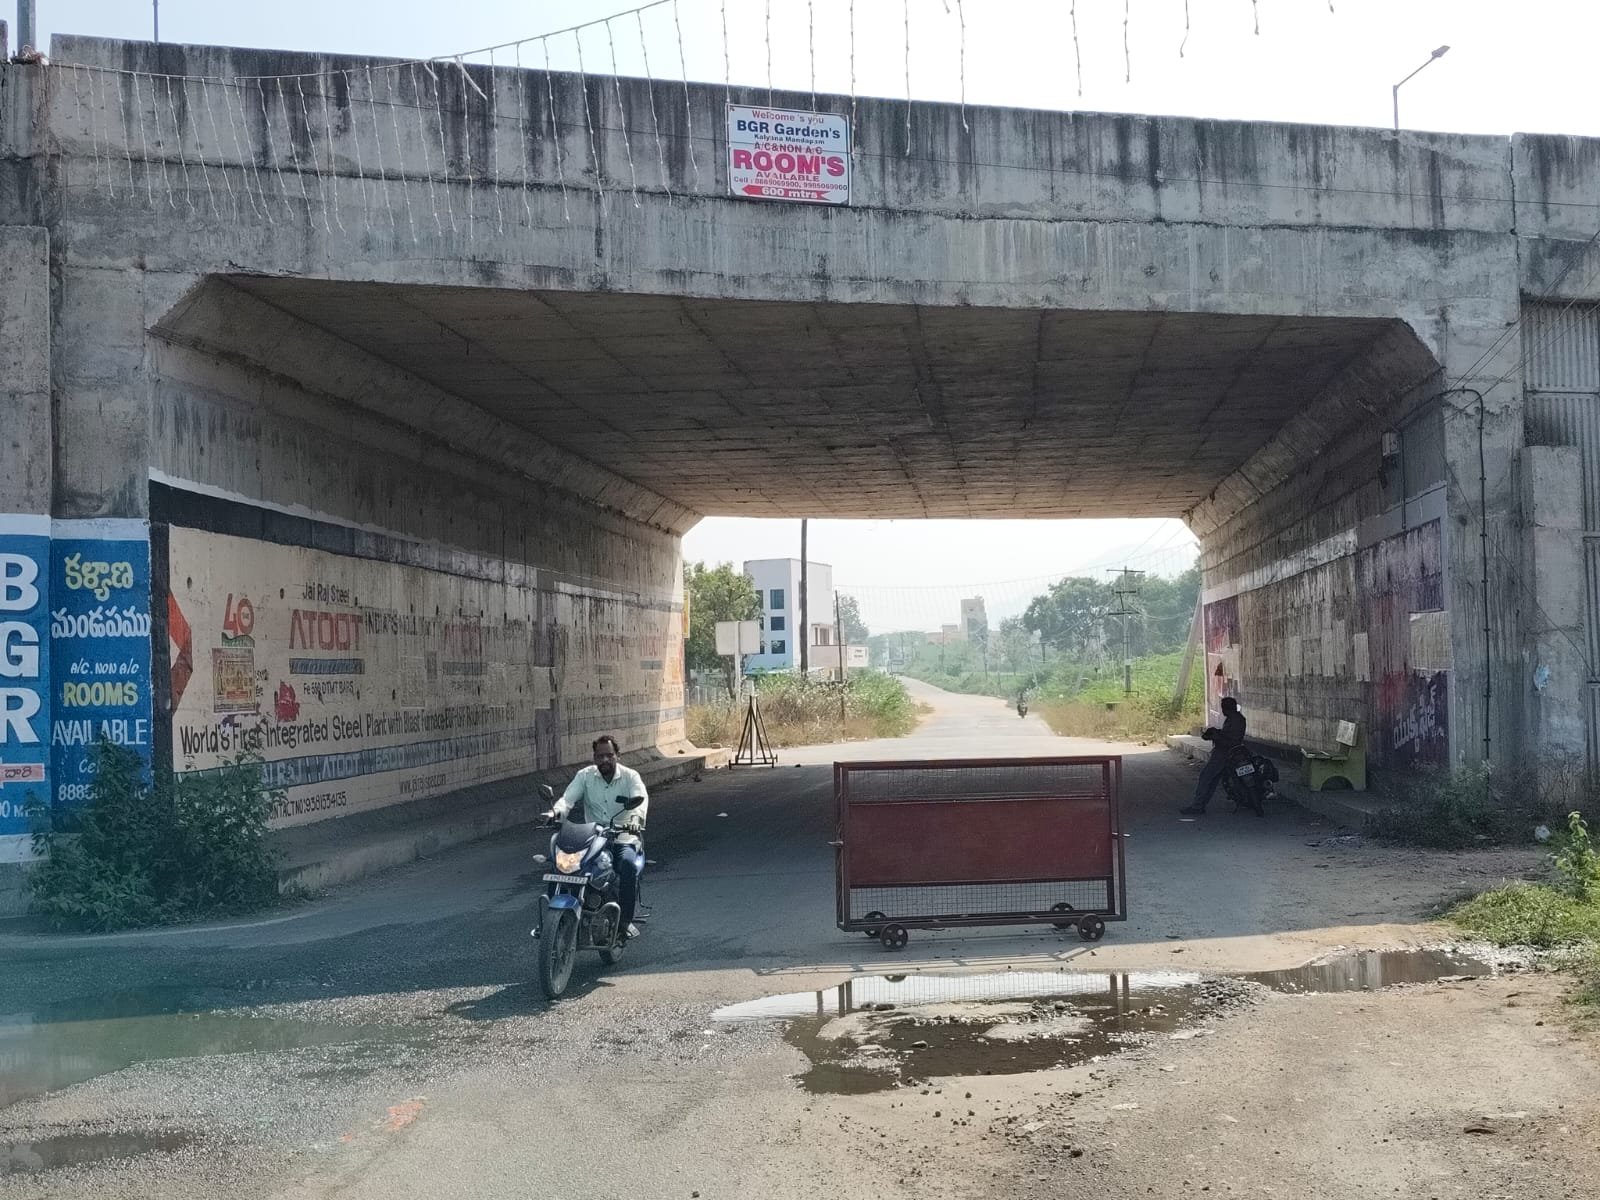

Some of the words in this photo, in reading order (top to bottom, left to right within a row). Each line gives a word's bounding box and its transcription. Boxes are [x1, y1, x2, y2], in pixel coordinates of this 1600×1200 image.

[752, 109, 795, 121] Welcome
[808, 115, 824, 125] you
[737, 120, 769, 133] BGR
[774, 123, 840, 139] Garden's
[733, 149, 845, 177] ROOM'S
[756, 171, 820, 182] AVAILABLE
[762, 188, 784, 197] 600
[788, 190, 818, 198] mtrs
[302, 581, 316, 600] Jai
[317, 583, 330, 605] Raj
[331, 585, 350, 603] Steel
[223, 592, 254, 635] 40
[95, 662, 118, 674] NON
[119, 657, 140, 674] A/C
[63, 682, 139, 707] ROOMS
[180, 724, 231, 755] World's
[264, 716, 328, 749] Integrated
[332, 714, 363, 741] Steel
[366, 712, 387, 737] Plant
